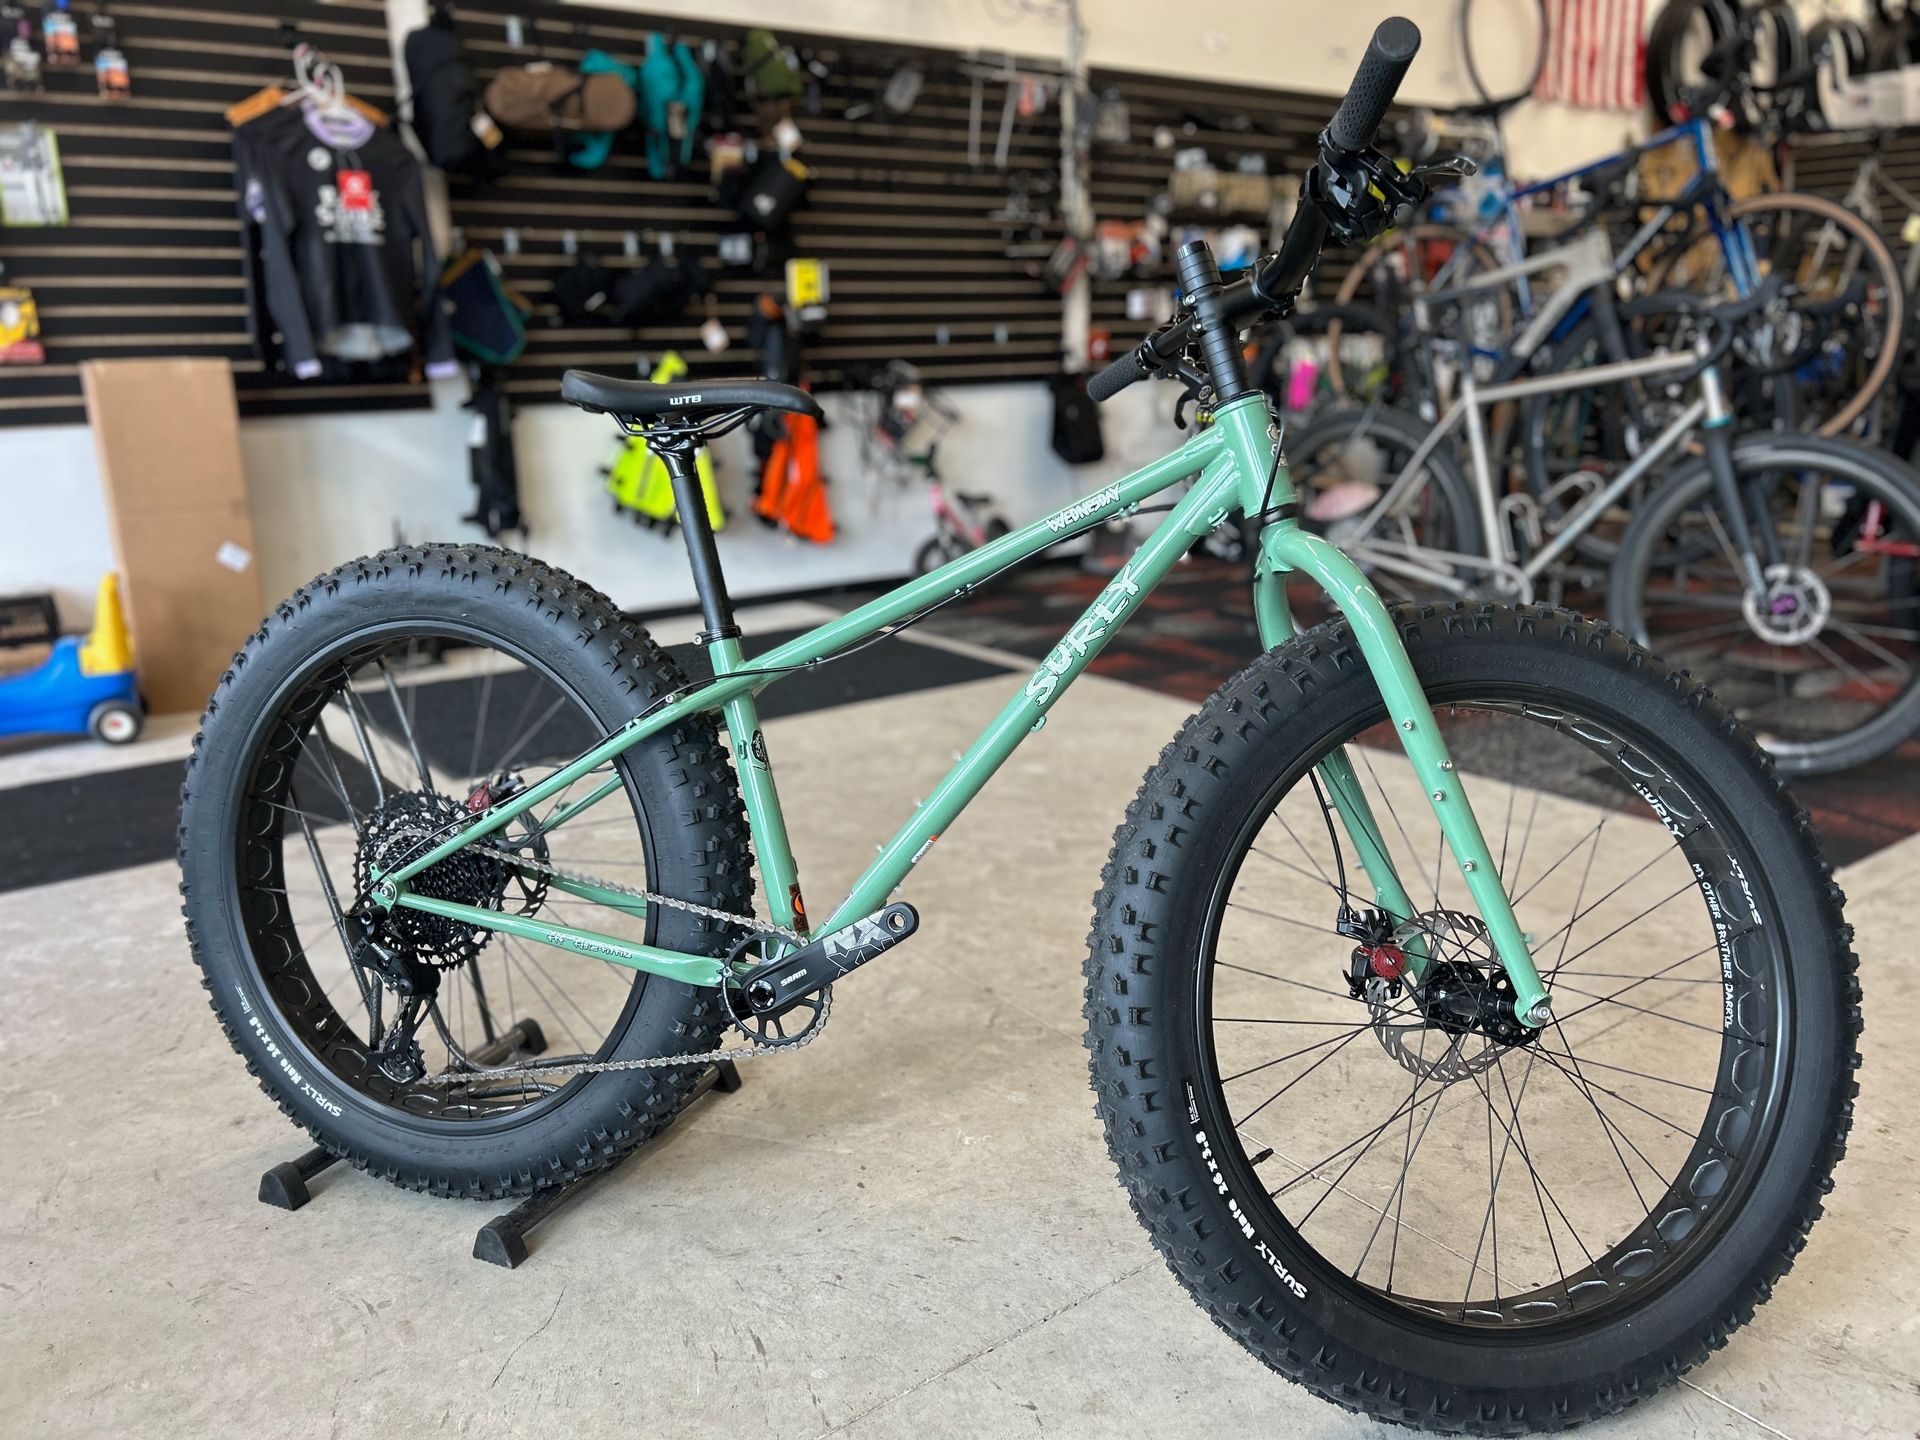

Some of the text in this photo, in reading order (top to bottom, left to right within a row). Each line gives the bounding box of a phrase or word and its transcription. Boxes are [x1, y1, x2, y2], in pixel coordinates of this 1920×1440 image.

[669, 394, 702, 406] WTB
[1044, 482, 1121, 534] WEDNESDAY
[1024, 563, 1141, 707] SURLY
[1702, 881, 1722, 920] OTHER
[1726, 853, 1763, 927] SURLY
[1715, 922, 1734, 980] BROTHER
[780, 968, 808, 988] SRAM
[1723, 983, 1735, 1029] DARRYL
[301, 1083, 343, 1117] SURLY
[1228, 1198, 1256, 1240] Nate
[1254, 1240, 1309, 1300] SURLY
